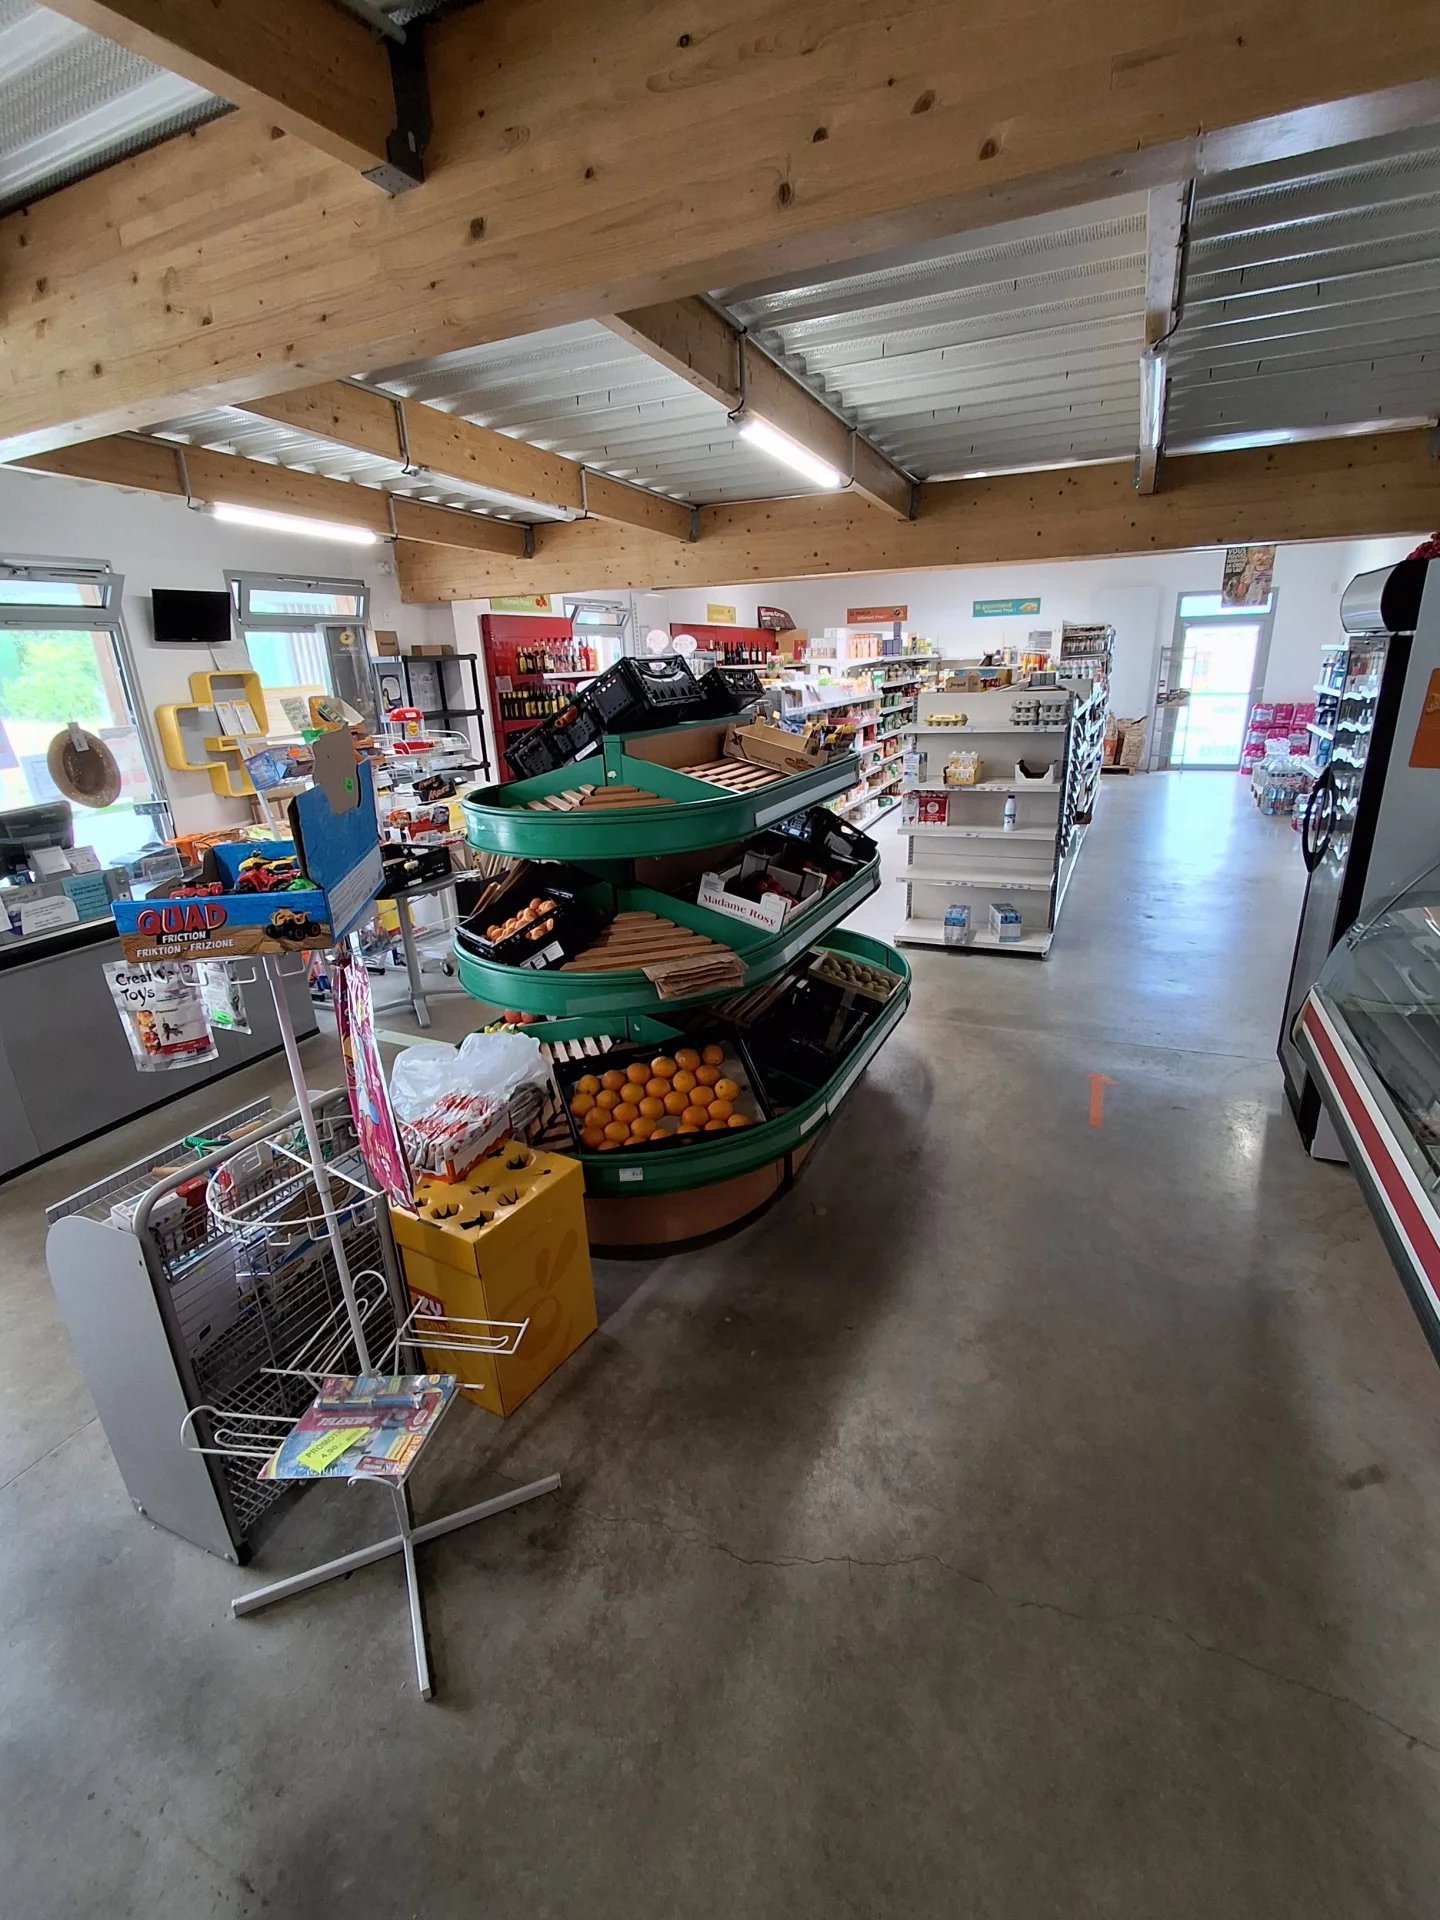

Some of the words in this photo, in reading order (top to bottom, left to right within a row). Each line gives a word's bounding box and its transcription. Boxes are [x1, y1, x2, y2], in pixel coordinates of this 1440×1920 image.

[137, 903, 228, 936] QUAD
[703, 894, 747, 914] Madame
[749, 908, 777, 928] Rosy
[162, 931, 206, 944] FRICTION
[136, 944, 181, 958] FRIKTION
[190, 938, 234, 951] FRIZIONE
[120, 987, 156, 1007] Toys
